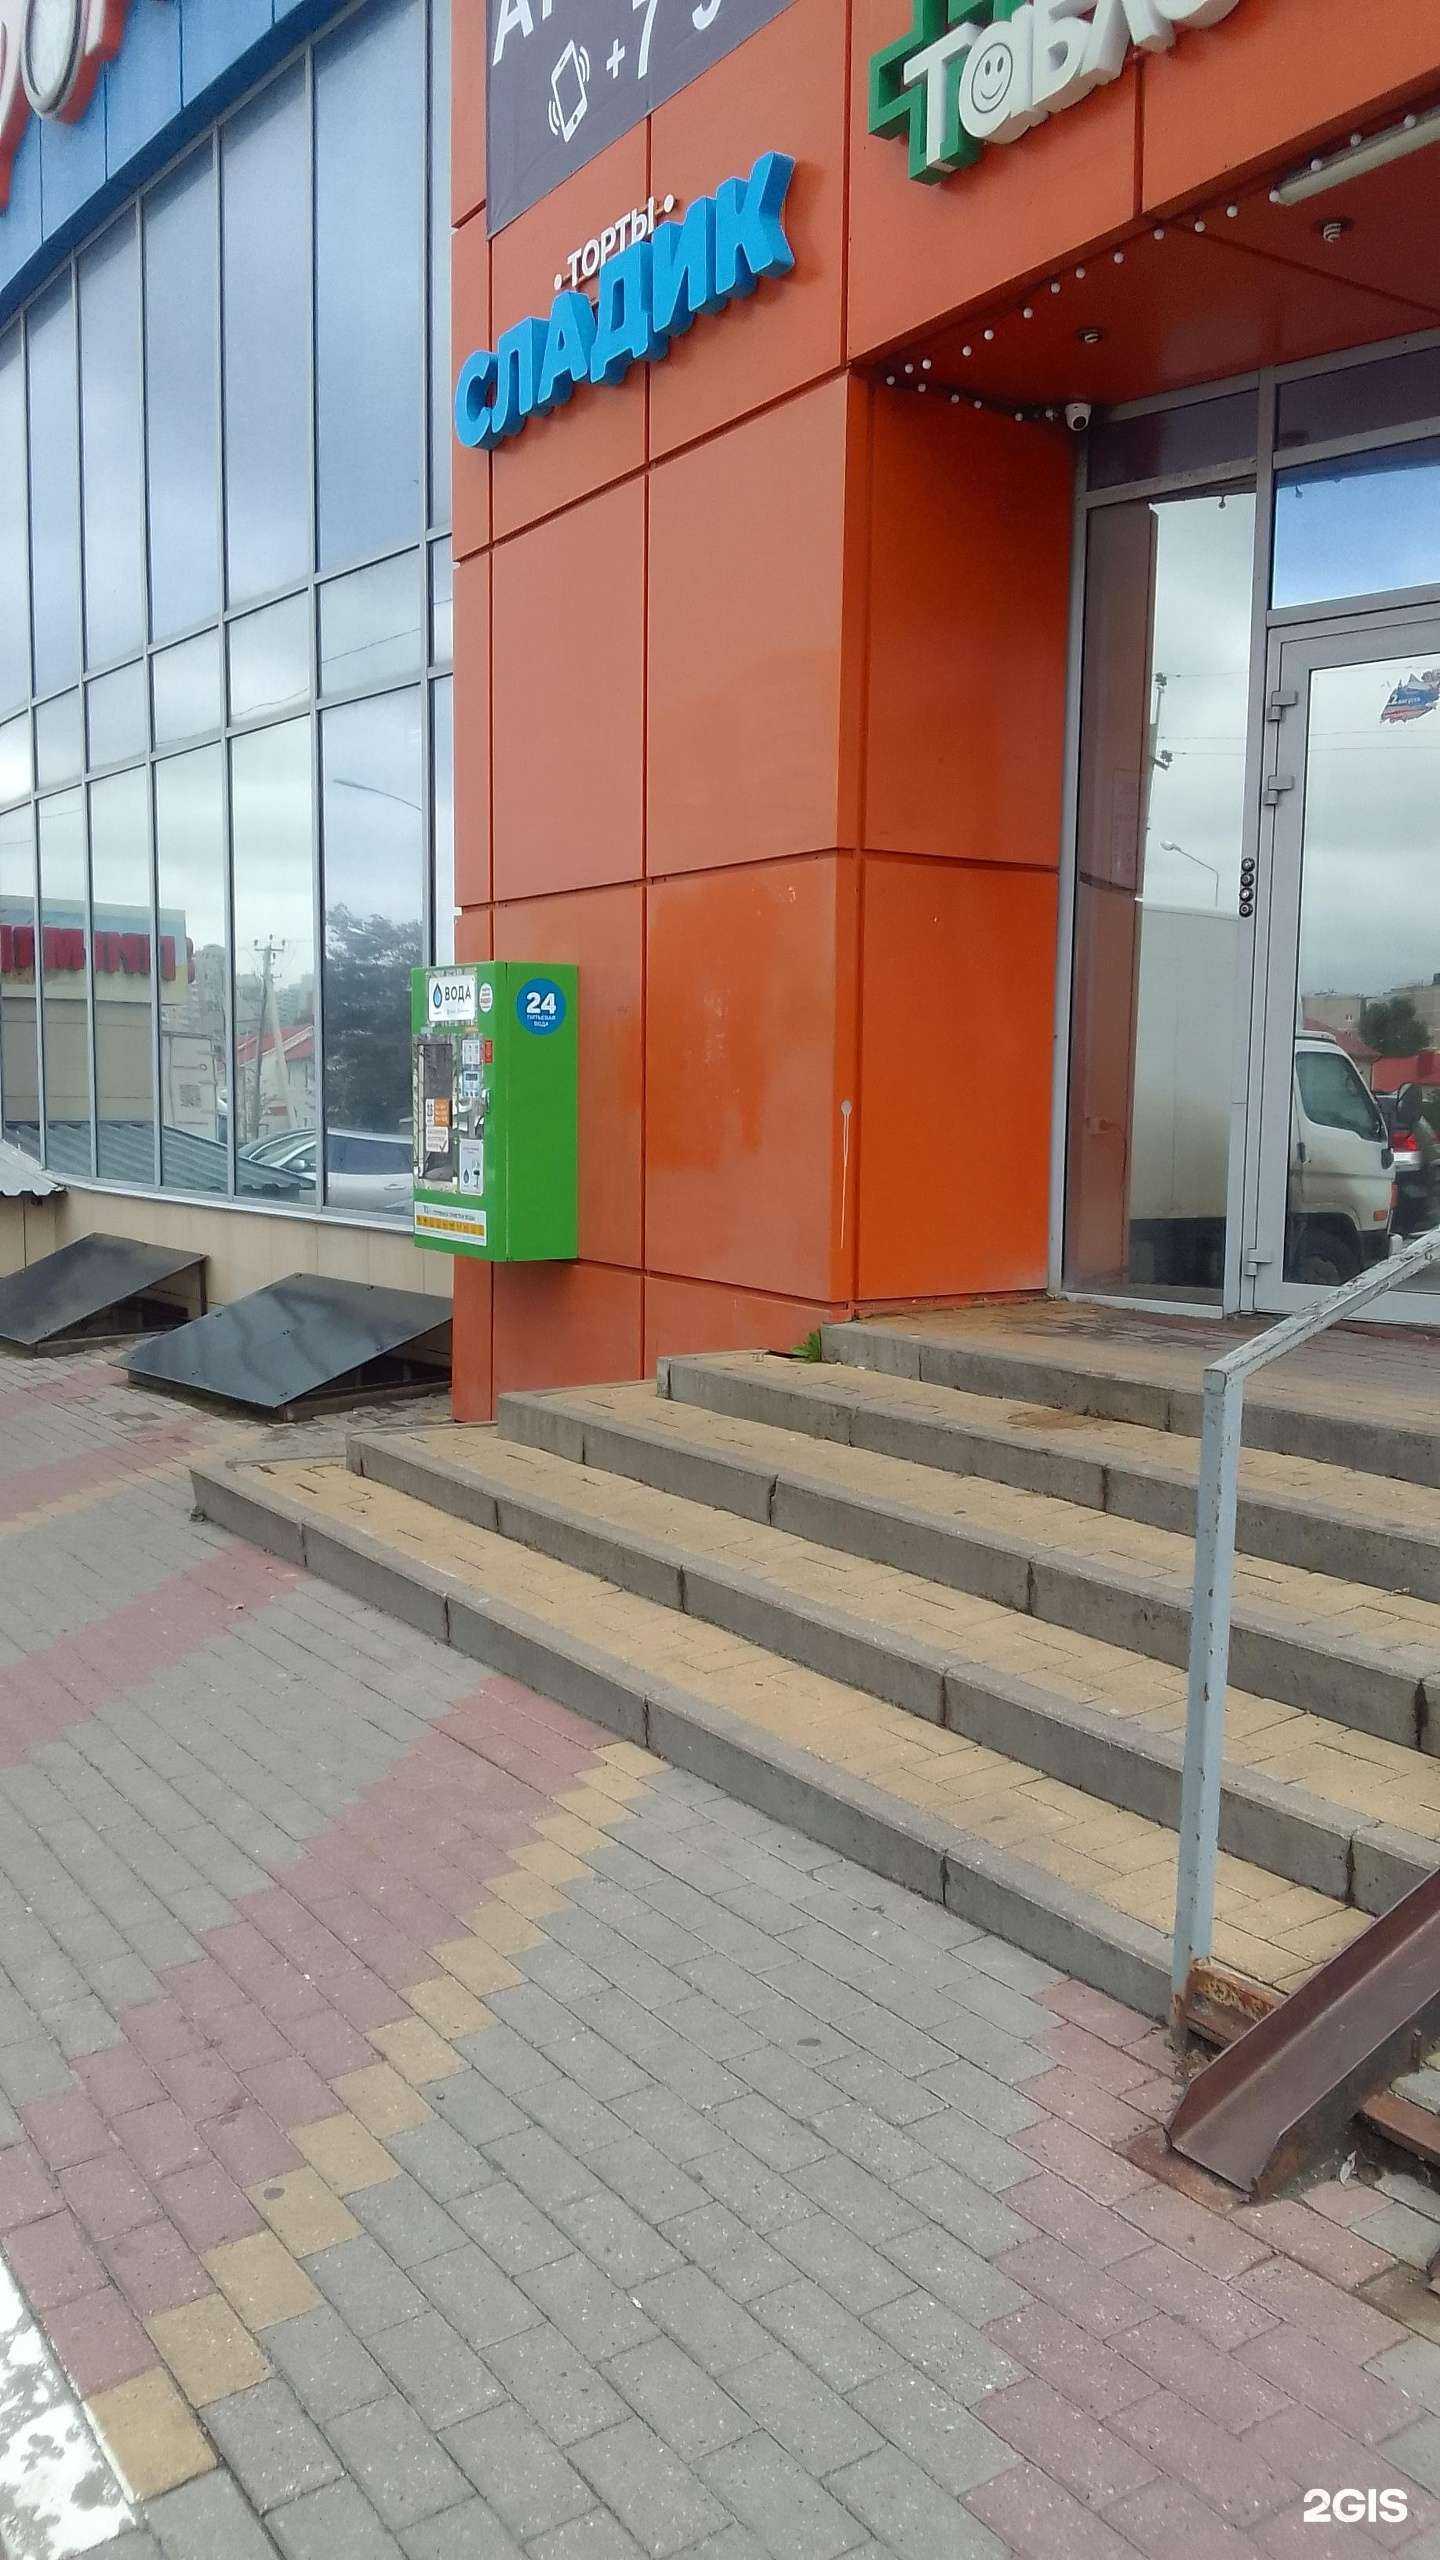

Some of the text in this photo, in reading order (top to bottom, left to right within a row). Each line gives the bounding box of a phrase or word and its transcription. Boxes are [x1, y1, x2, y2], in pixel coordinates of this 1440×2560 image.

[567, 196, 655, 287] ТОРТЫ
[454, 151, 796, 449] СЛАДИК
[444, 985, 472, 1003] ВОДА
[526, 991, 557, 1015] 24
